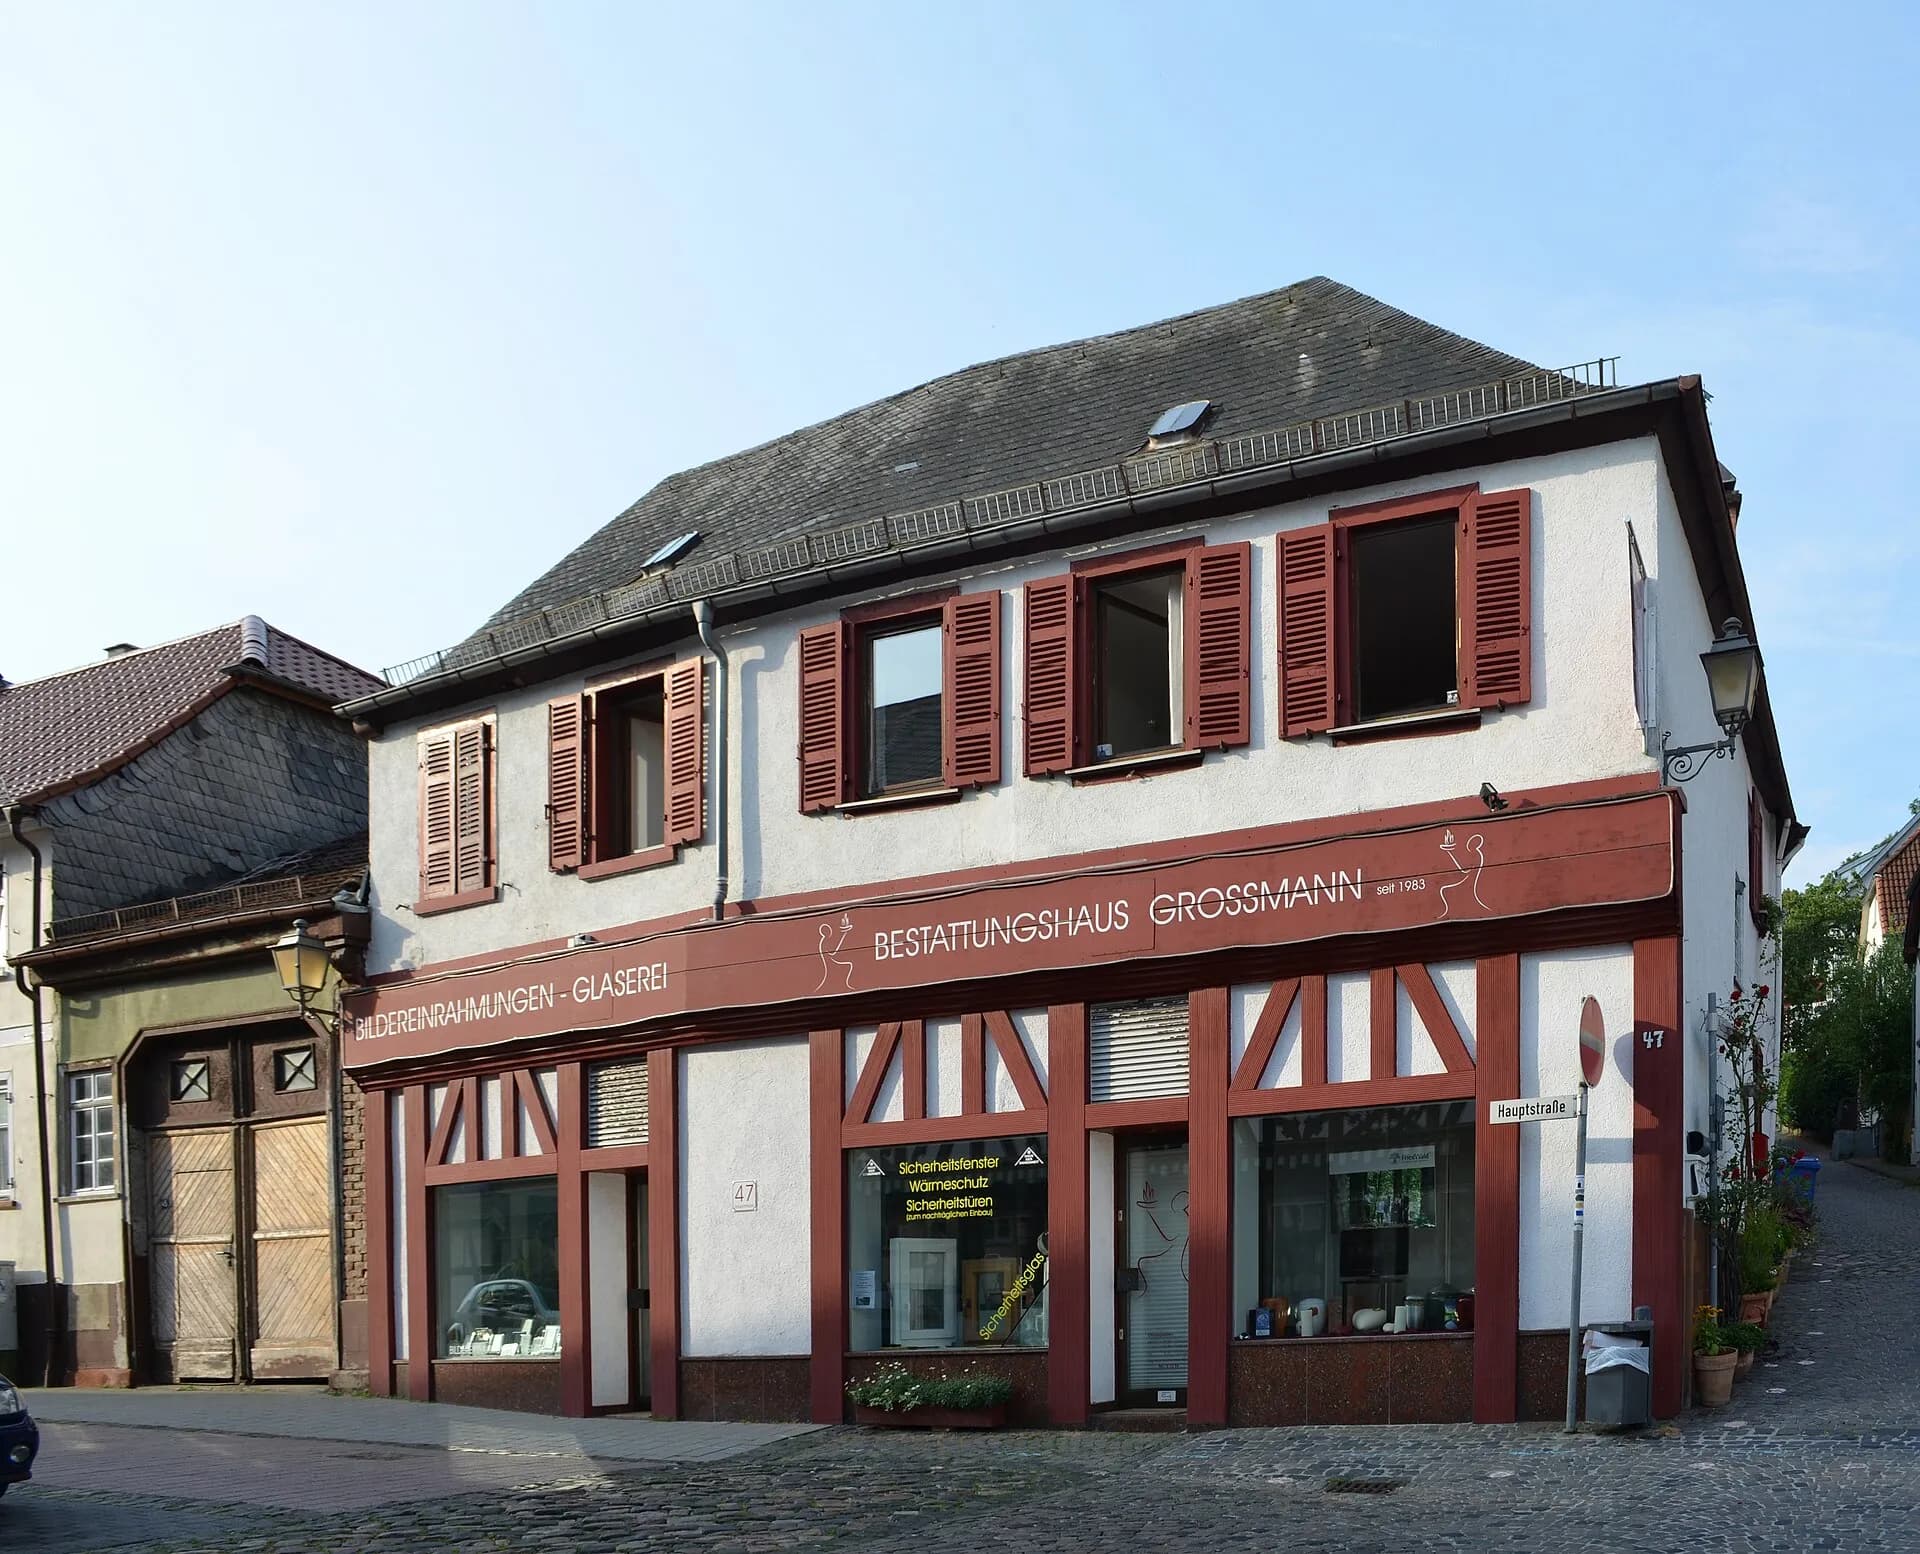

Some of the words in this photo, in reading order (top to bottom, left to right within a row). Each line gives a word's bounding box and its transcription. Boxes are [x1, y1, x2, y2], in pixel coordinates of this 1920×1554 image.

[874, 900, 1129, 962] BESTATTUNGSHAUS
[1149, 868, 1363, 926] GROSSMANN
[1376, 882, 1395, 896] seit
[1398, 878, 1426, 893] 1983
[355, 983, 554, 1041] BILDEREINRAHMUNGEN
[573, 962, 668, 1003] GLASEREI
[1642, 1030, 1664, 1049] 47
[1498, 1100, 1566, 1120] Hauptstraße
[899, 1156, 1000, 1176] Sicherheitsfenster
[735, 1184, 754, 1202] 47
[909, 1175, 989, 1193] Wärmeschutz
[906, 1195, 993, 1212] Sicherheitstüren
[979, 1252, 1045, 1341] Sicherheitsglas
